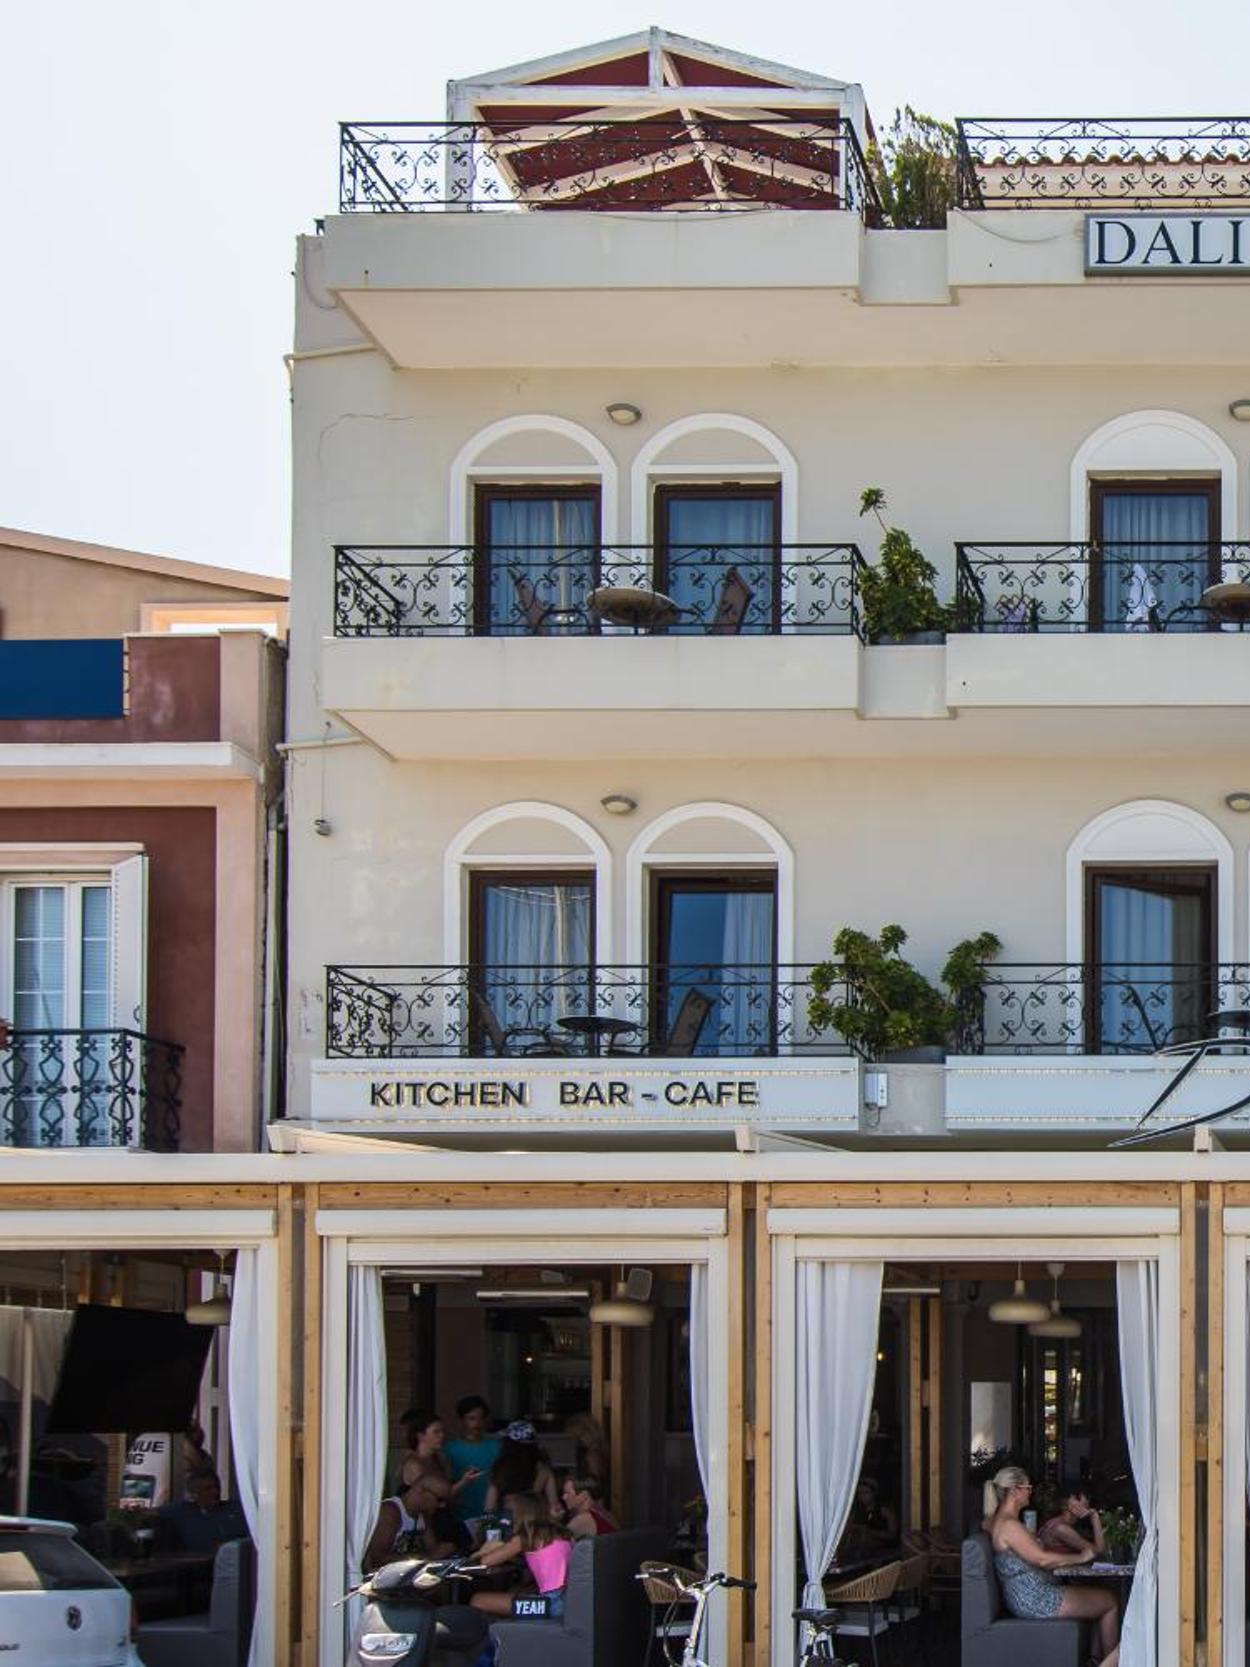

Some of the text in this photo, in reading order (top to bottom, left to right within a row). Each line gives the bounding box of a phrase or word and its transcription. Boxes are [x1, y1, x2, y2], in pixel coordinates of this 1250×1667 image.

[1094, 219, 1245, 265] DALI
[369, 1081, 528, 1107] KITCHEN
[558, 1081, 630, 1107] BAR
[663, 1081, 760, 1107] CAFE
[515, 1600, 546, 1615] YEAH
